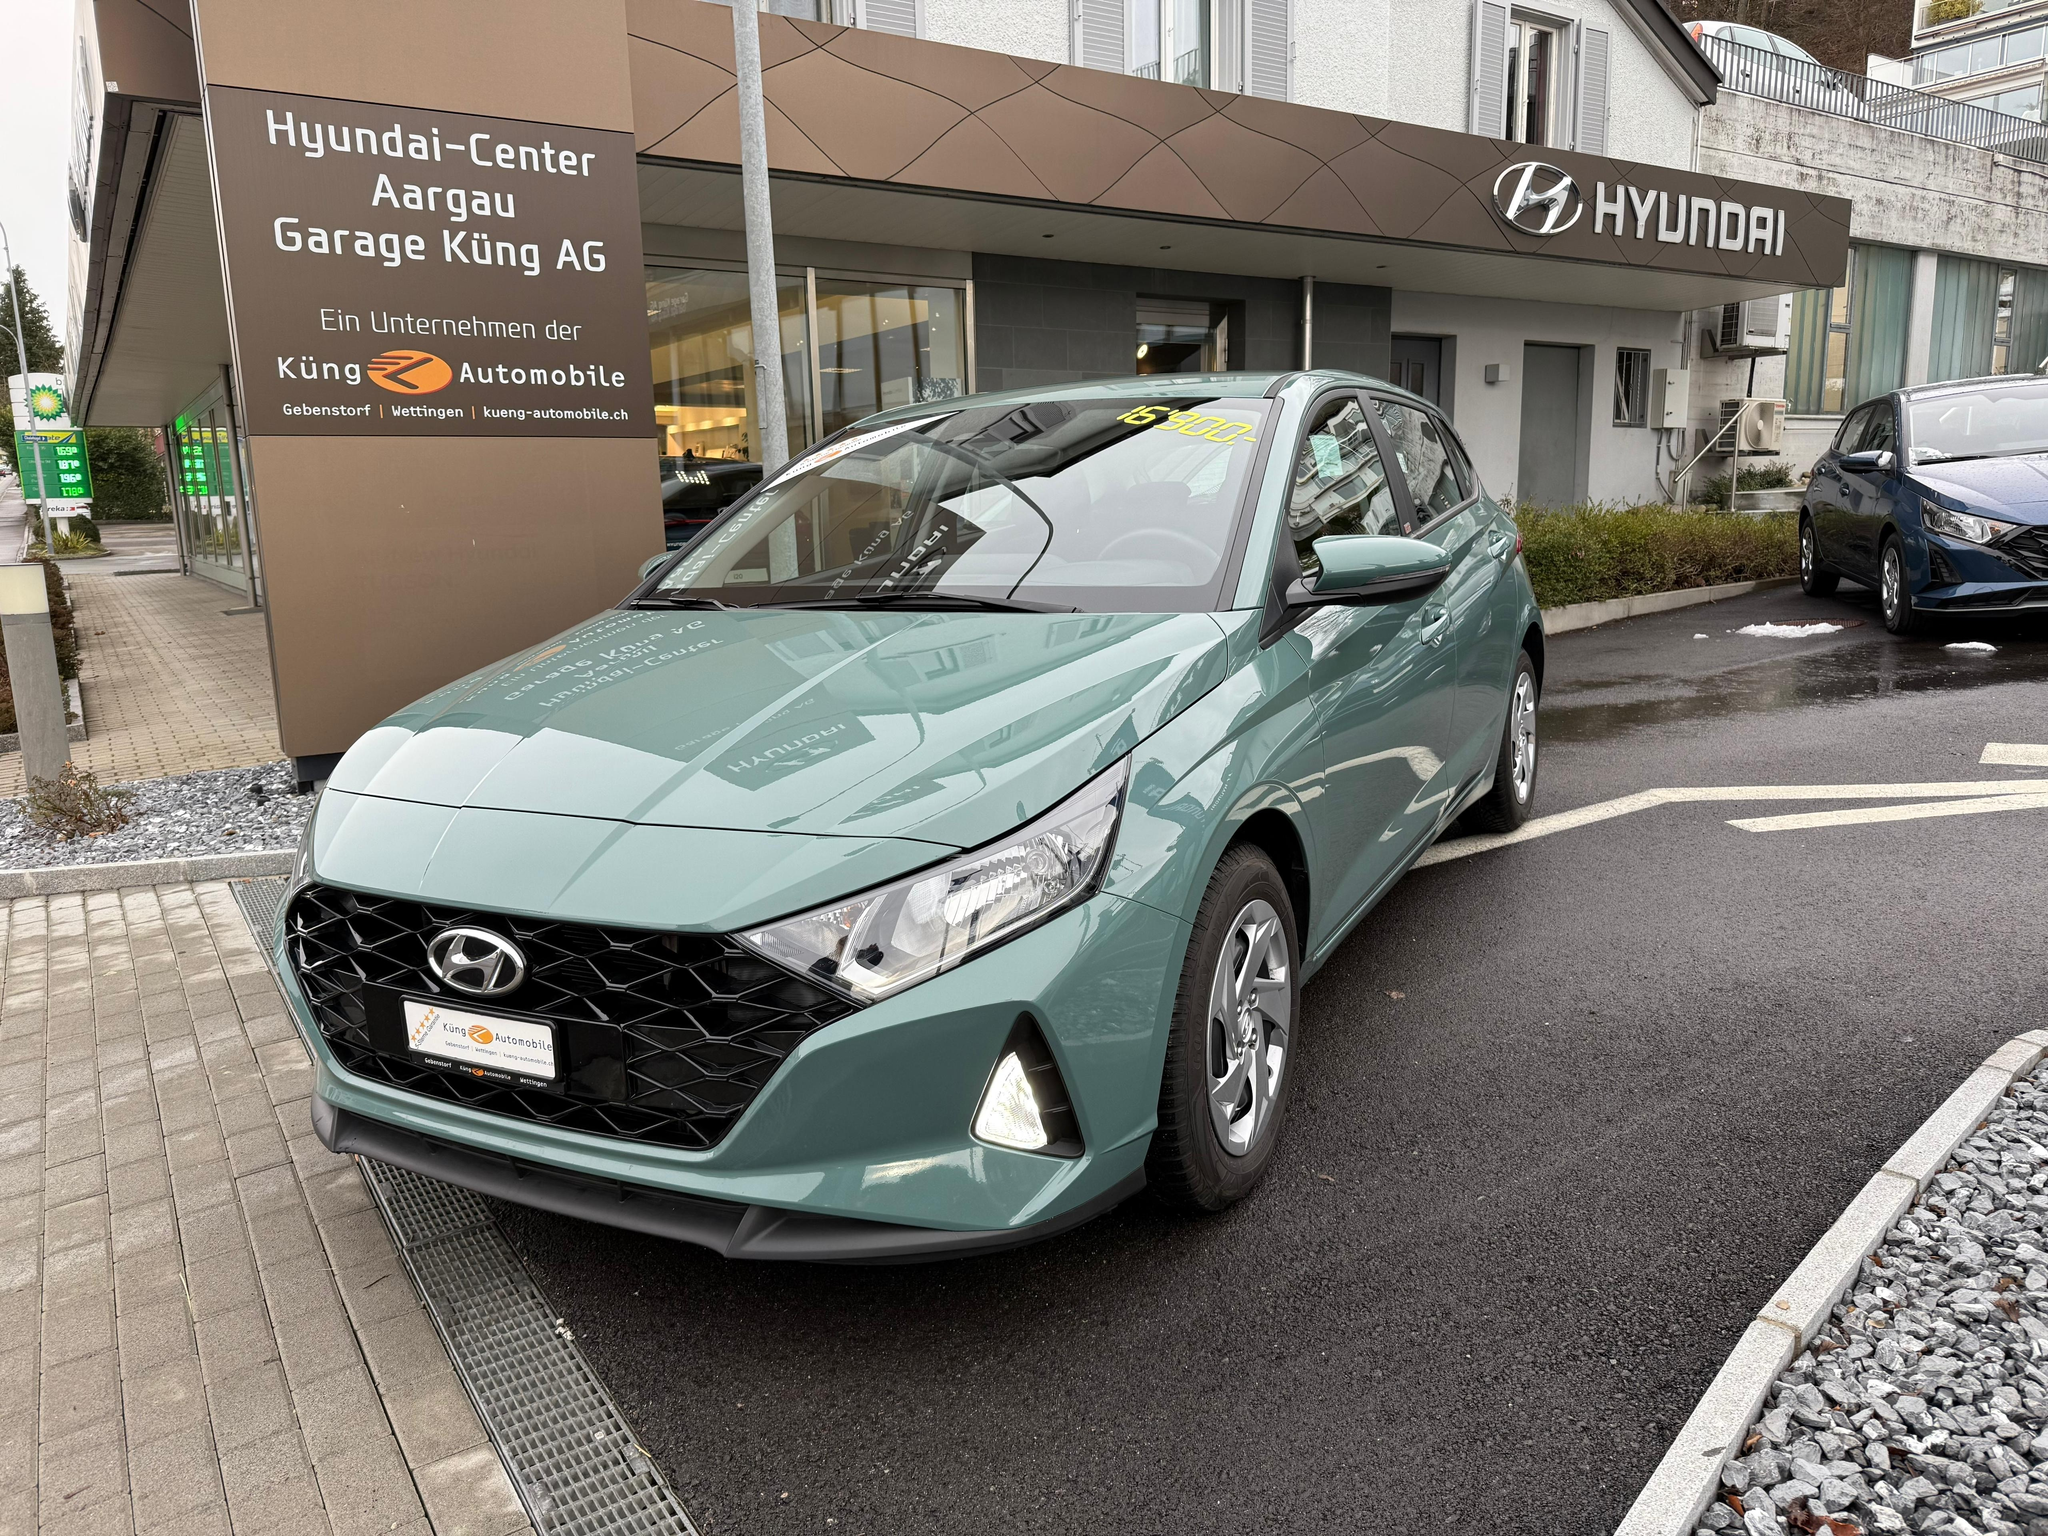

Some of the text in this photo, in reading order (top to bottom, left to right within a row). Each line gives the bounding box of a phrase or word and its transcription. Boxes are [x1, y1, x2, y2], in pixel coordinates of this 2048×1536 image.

[266, 109, 596, 177] Hyundai-Center
[371, 173, 515, 222] Aargau
[1593, 181, 1787, 257] HYUNDAI
[273, 216, 607, 277] Garage Küng AG
[320, 308, 583, 341] Ein Unternehmen der
[277, 355, 626, 388] Küng Automobile
[282, 403, 629, 421] Gebenstorf Wettingen kueng-automobile.ch
[442, 1022, 553, 1052] Küng Automobile
